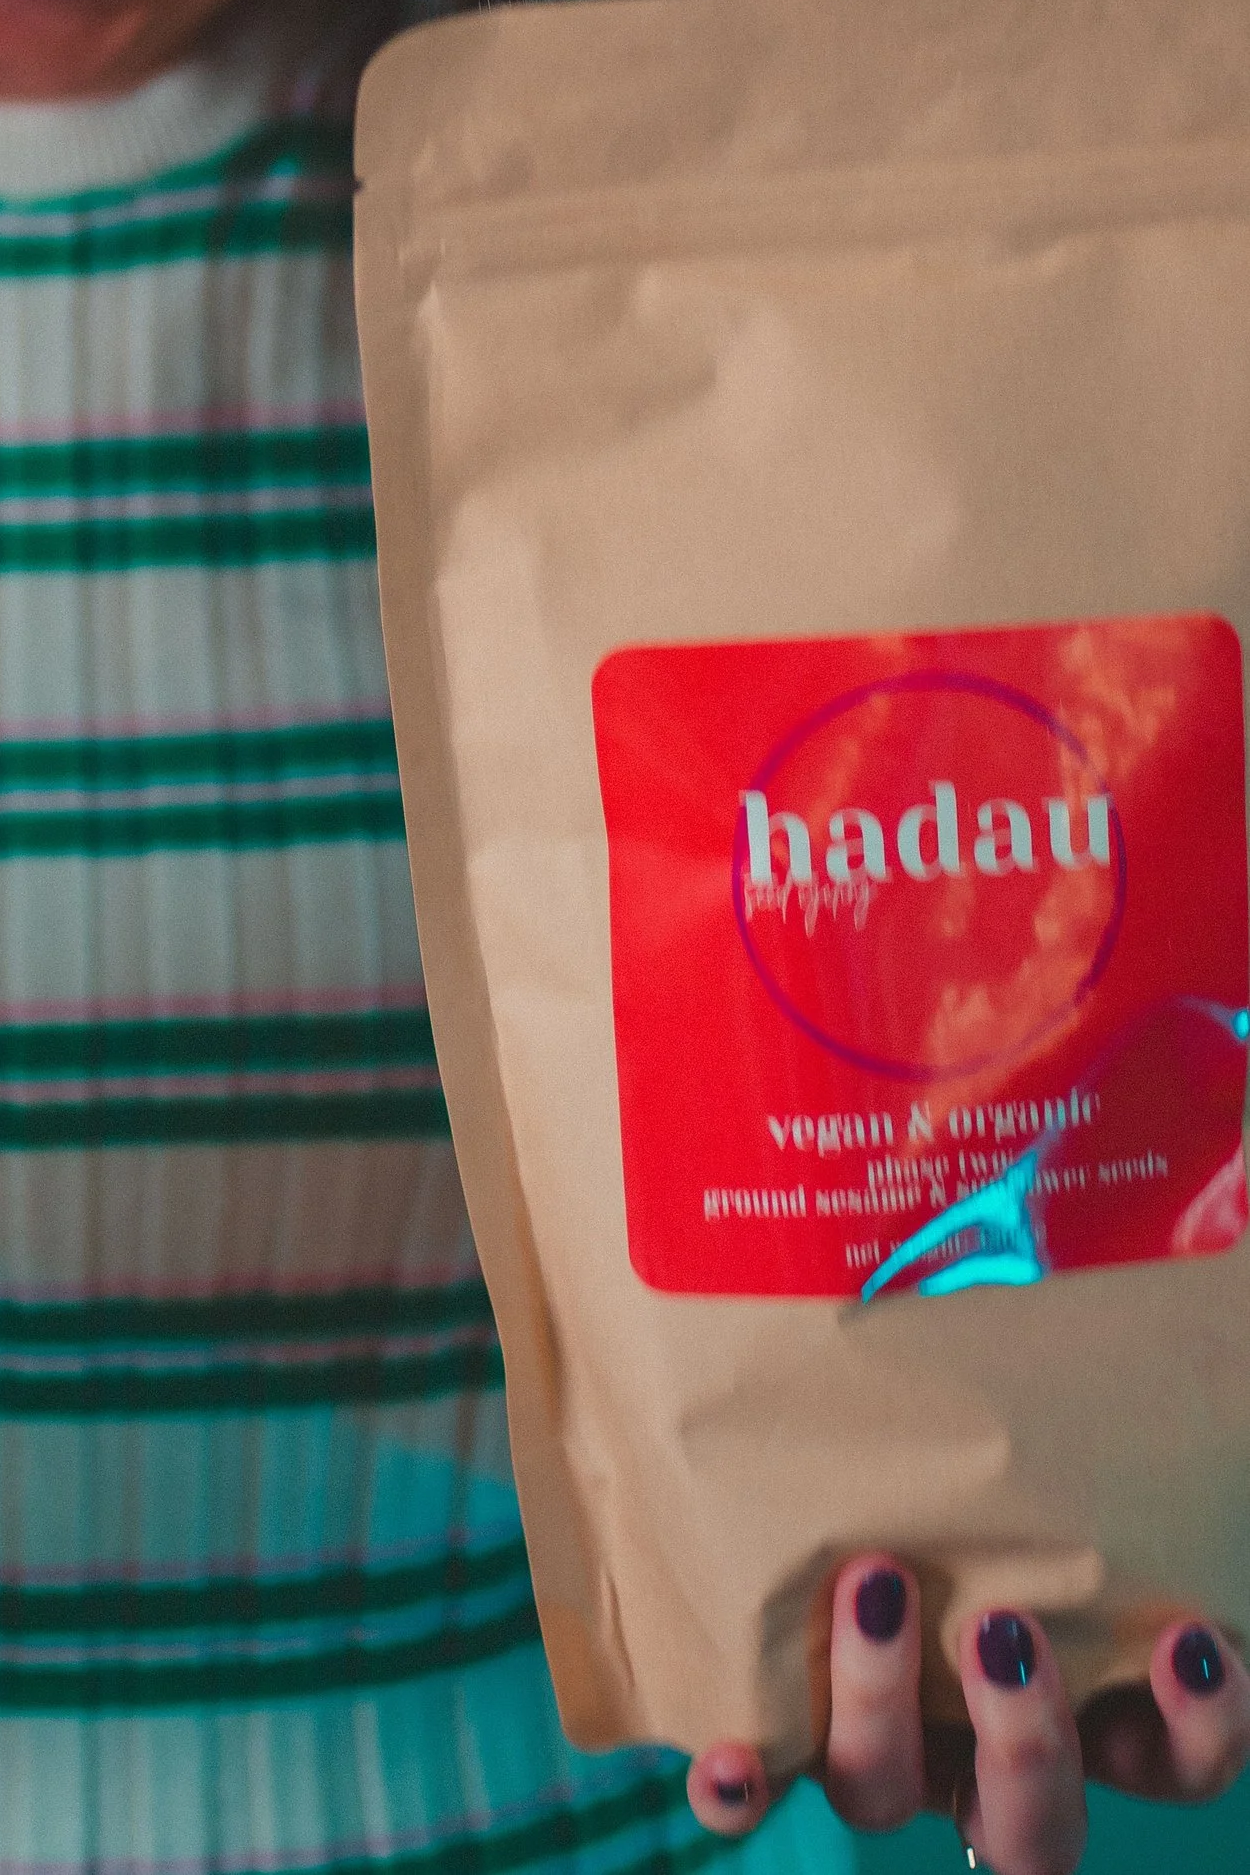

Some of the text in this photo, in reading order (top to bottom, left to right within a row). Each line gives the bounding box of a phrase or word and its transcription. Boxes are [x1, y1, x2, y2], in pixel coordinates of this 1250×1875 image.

[738, 780, 1111, 887] hadau
[766, 1086, 1101, 1159] vegan & organic
[867, 1154, 950, 1190] phase
[703, 1183, 807, 1222] ground
